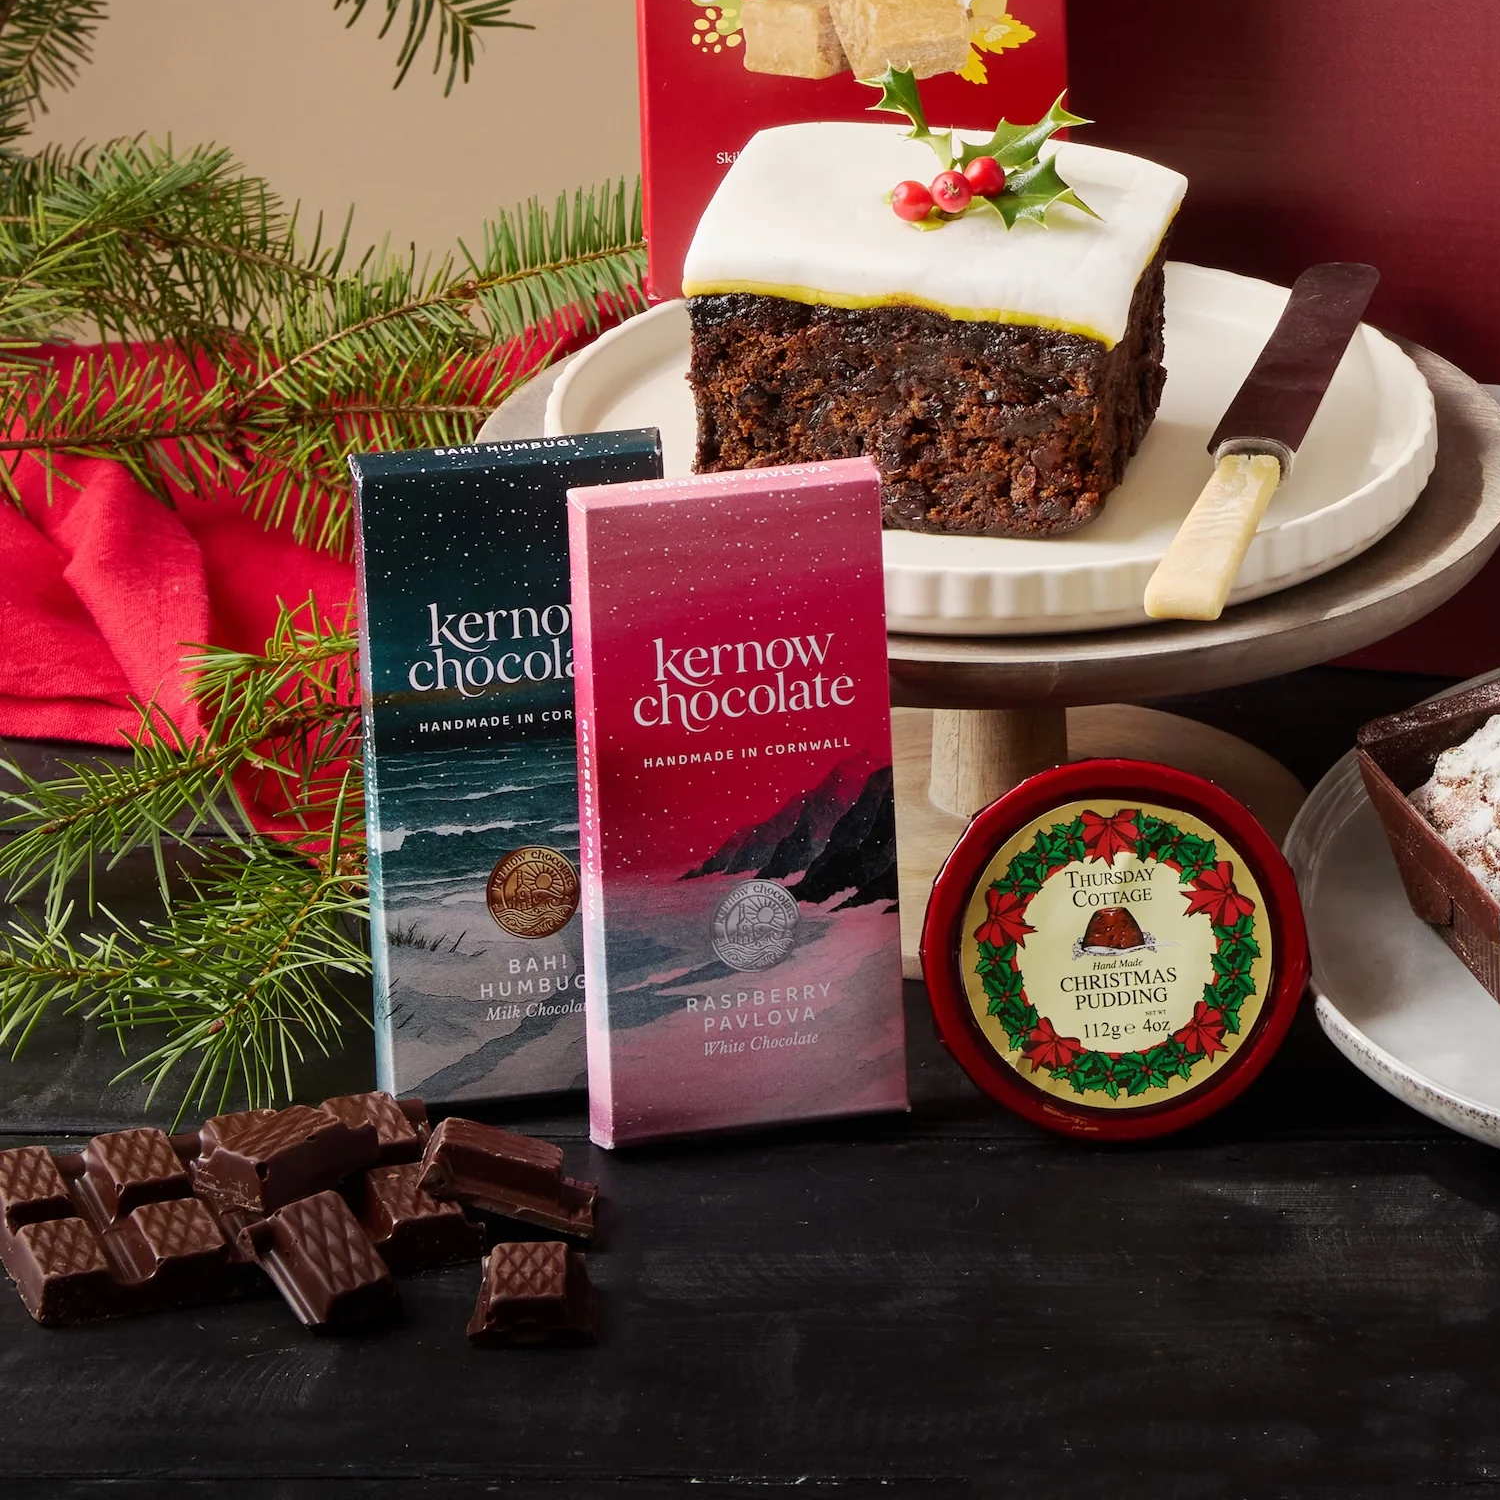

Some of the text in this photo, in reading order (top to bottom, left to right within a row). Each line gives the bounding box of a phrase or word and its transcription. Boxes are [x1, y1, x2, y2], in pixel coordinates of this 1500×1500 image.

[434, 438, 577, 457] BAH! HUMBUG!
[627, 464, 831, 493] RASPBERRY PAVLOVA
[653, 633, 835, 688] kernow
[633, 671, 856, 733] chocolate
[419, 713, 534, 733] HANDMADE IN
[643, 737, 852, 768] HANDMADE IN CORNWALL
[714, 883, 797, 927] kernow chocolate
[508, 954, 567, 974] BAH!
[1092, 958, 1143, 972] Hand Made
[1060, 967, 1177, 993] CHRISTMAS
[686, 982, 831, 1013] RASPBERRY
[1075, 987, 1168, 1011] PUDDING
[486, 1004, 521, 1022] Milk
[704, 1006, 816, 1033] PAVLOVA
[1083, 1017, 1171, 1040] 112g 4oz
[704, 1031, 819, 1057] White Chocolate
